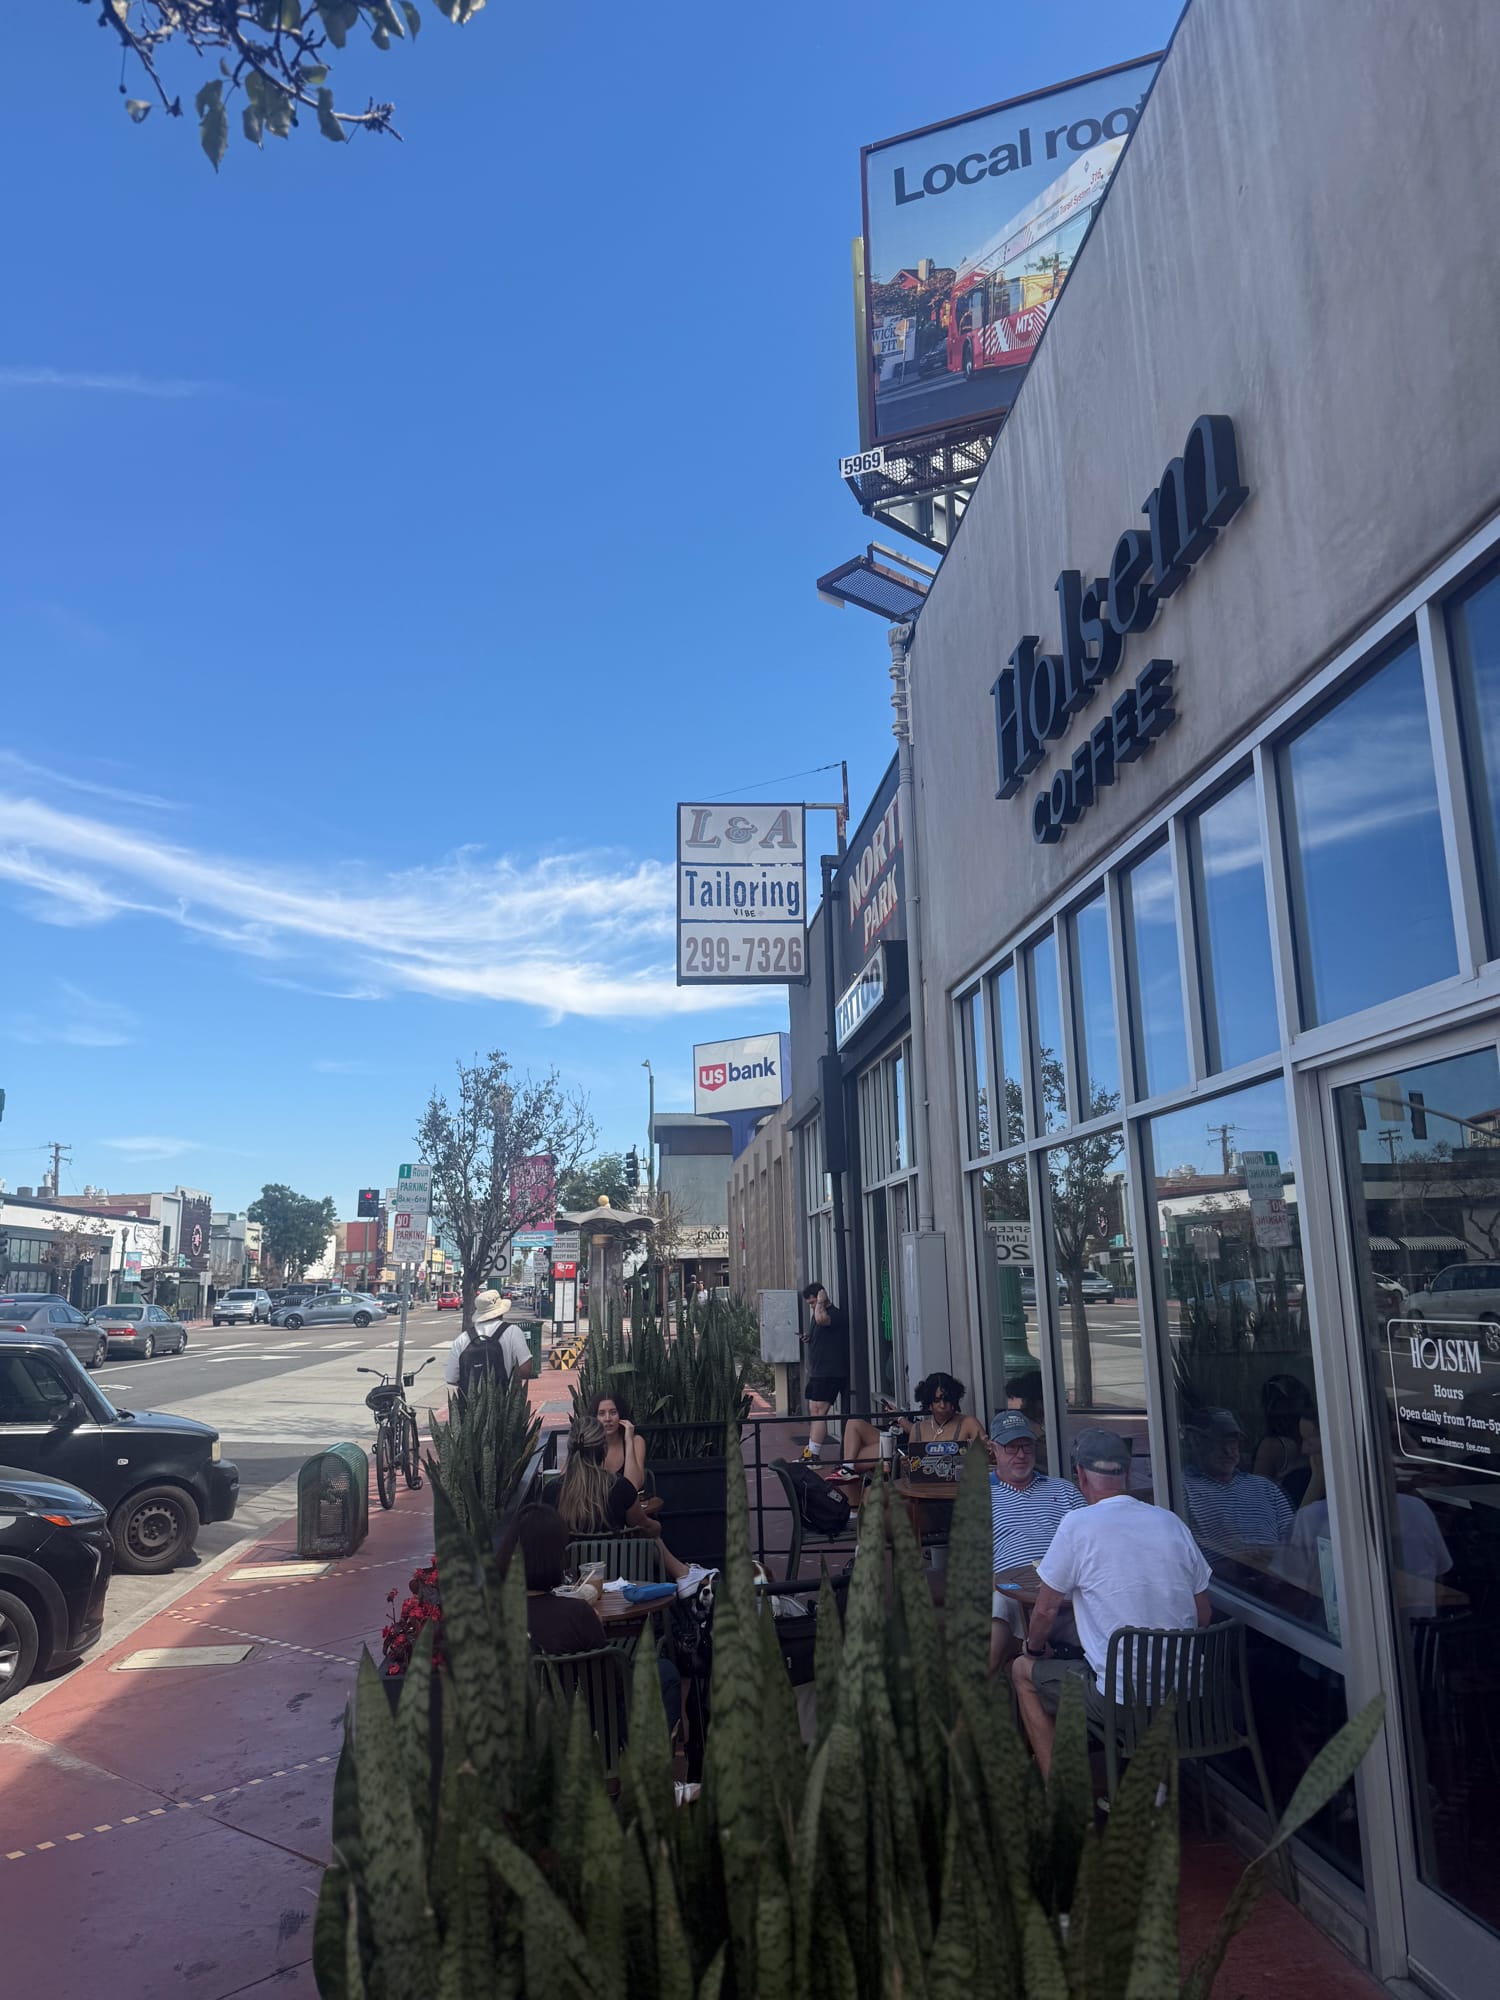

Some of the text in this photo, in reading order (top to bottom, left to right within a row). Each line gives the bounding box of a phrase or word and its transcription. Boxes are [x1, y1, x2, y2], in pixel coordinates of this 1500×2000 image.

[894, 93, 1149, 206] Local roo
[1015, 312, 1034, 334] MTS
[881, 340, 897, 352] FIT
[844, 452, 881, 475] 5969
[990, 415, 1250, 799] Holsem
[1032, 659, 1177, 844] COFFEE
[685, 870, 800, 916] Tailoring
[734, 908, 756, 918] VIBE
[864, 864, 898, 948] PARK
[686, 937, 801, 973] 299-7326
[836, 958, 881, 1040] TATTOO
[729, 1056, 776, 1081] bank
[412, 1168, 428, 1177] HOUR
[401, 1183, 428, 1192] PARKING
[397, 1215, 409, 1226] NO
[397, 1231, 425, 1240] PARKING
[1410, 1337, 1482, 1374] HOLSEM
[1433, 1384, 1464, 1400] Hours
[1400, 1406, 1421, 1420] Open
[1422, 1408, 1442, 1425] daily
[1443, 1413, 1465, 1426] from
